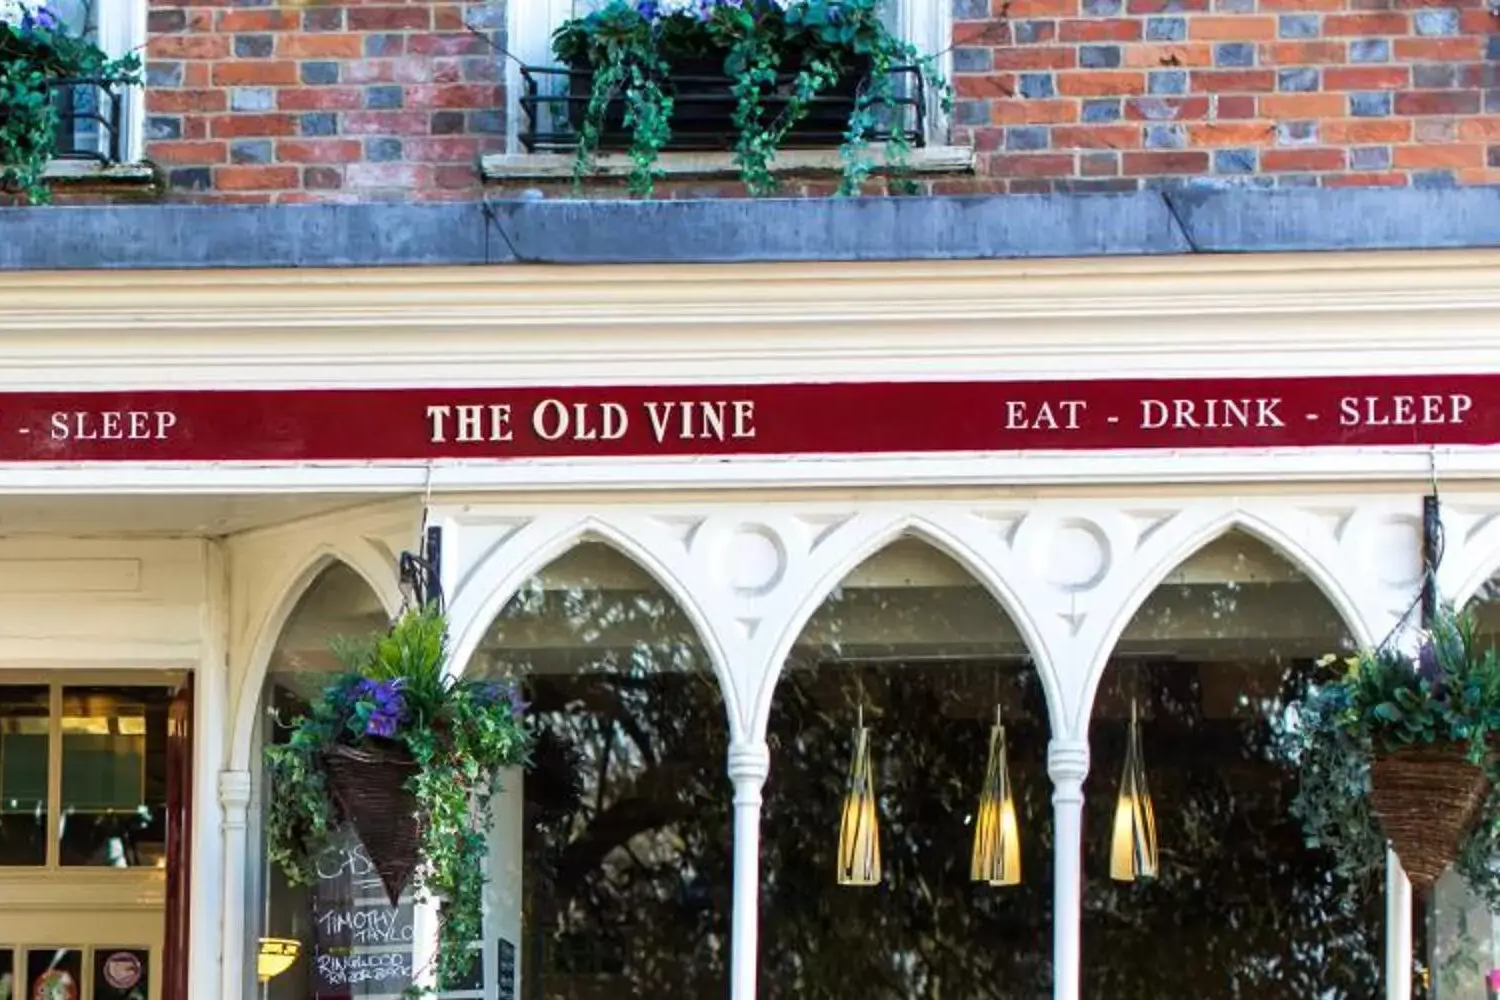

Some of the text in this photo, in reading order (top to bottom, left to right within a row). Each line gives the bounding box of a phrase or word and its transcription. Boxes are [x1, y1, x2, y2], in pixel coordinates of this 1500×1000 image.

[50, 411, 178, 441] SLEEP
[427, 399, 756, 443] THE OLD VINE
[1005, 400, 1087, 430] EAT
[1140, 398, 1285, 429] DRINK
[1339, 394, 1473, 426] SLEEP
[319, 909, 399, 936] TIMOTHY
[355, 925, 414, 943] TAYLO
